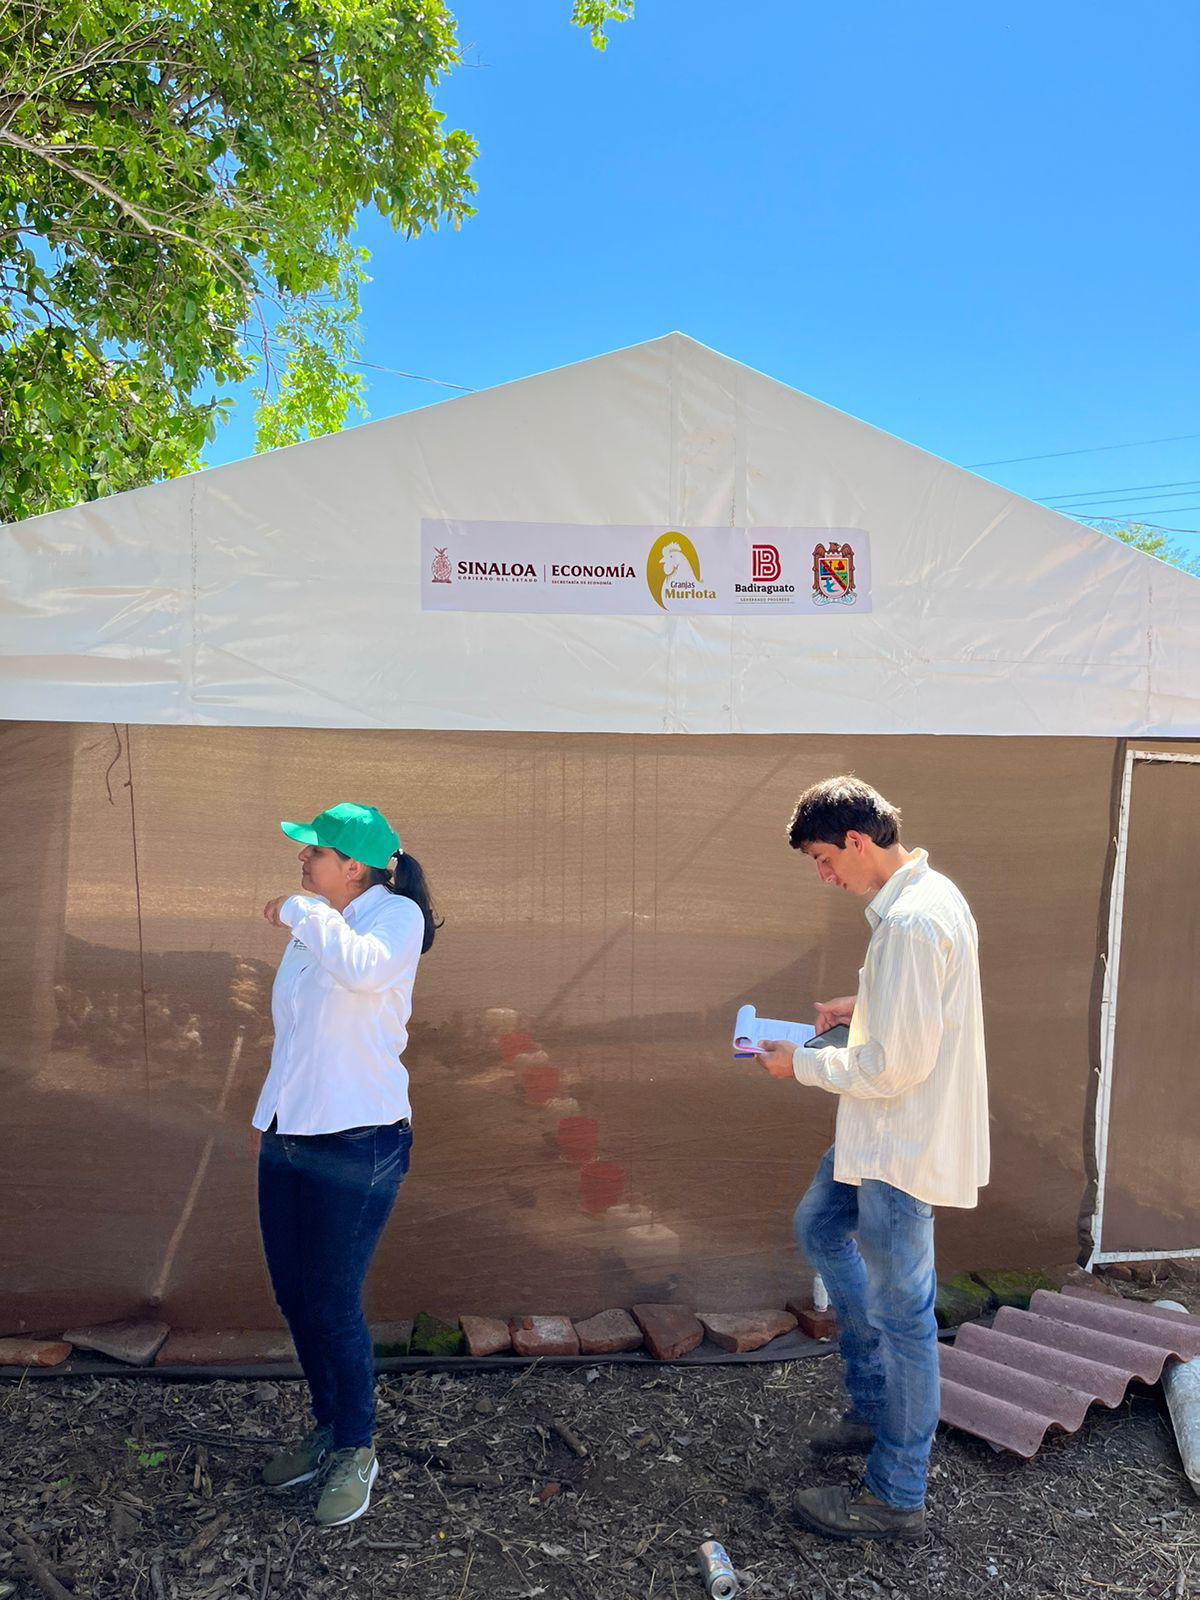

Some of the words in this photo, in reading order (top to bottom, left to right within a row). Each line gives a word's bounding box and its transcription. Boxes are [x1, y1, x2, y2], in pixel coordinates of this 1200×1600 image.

[457, 561, 537, 577] SINALOA
[551, 563, 636, 578] ECONOMÍA
[670, 580, 696, 590] Granjas
[734, 583, 795, 595] Badiraguato
